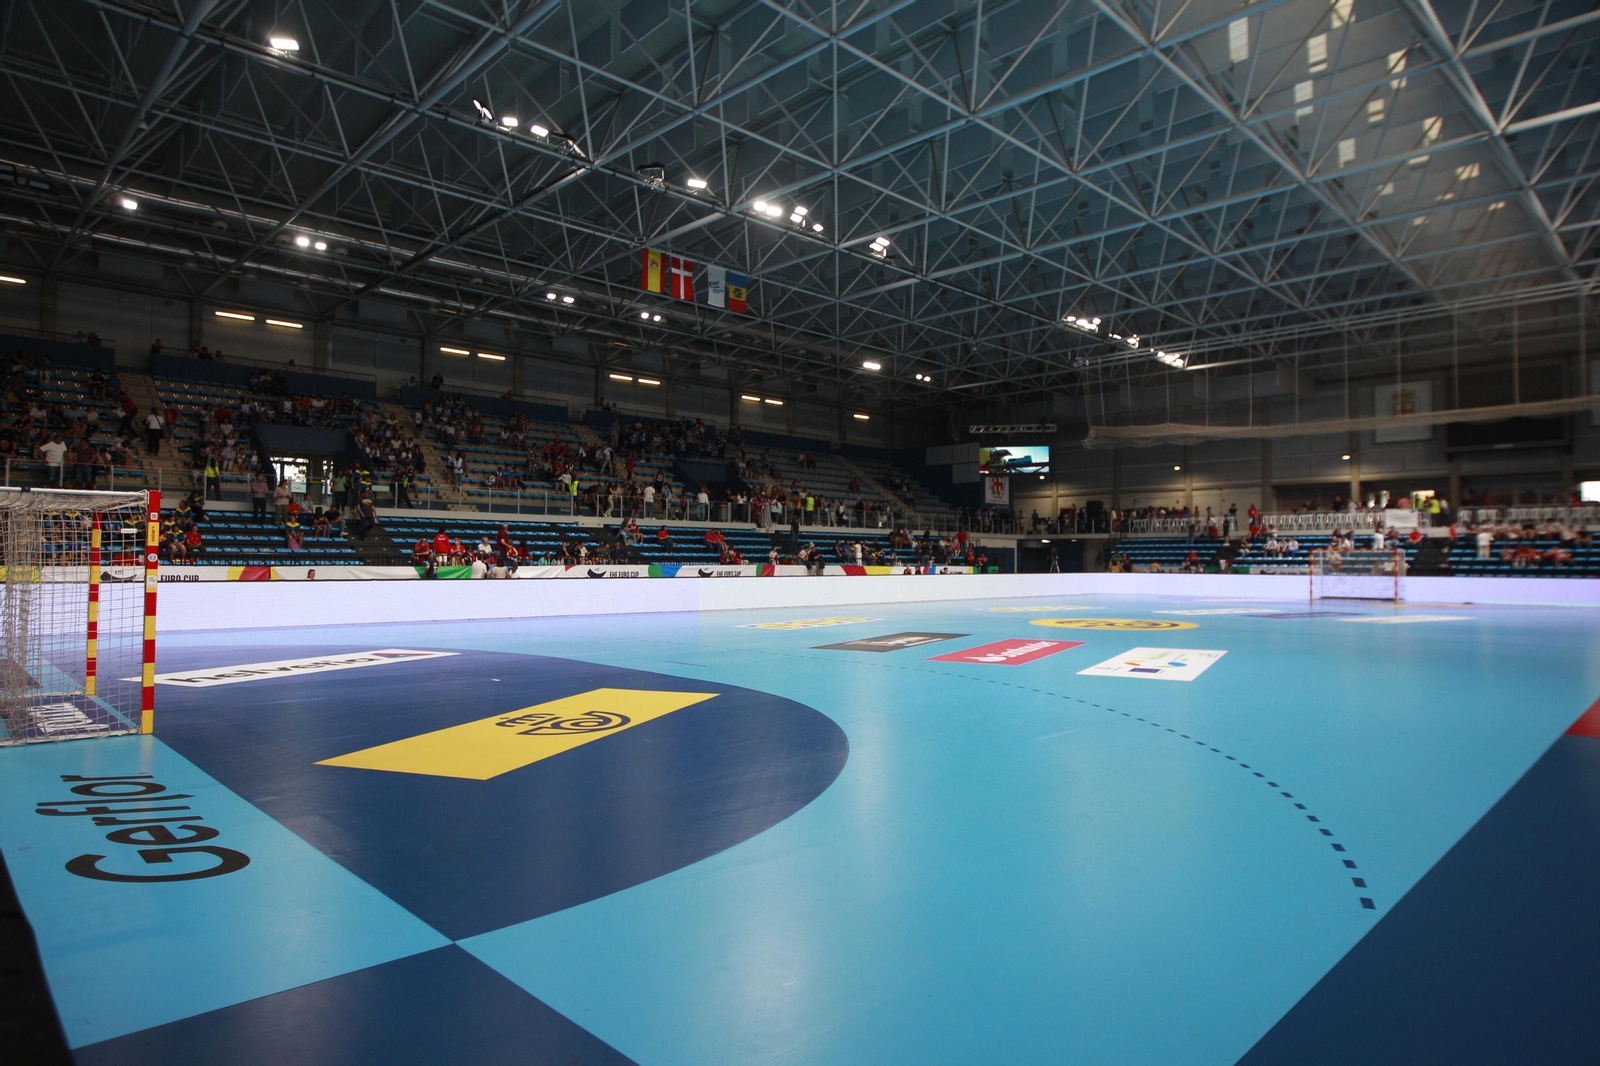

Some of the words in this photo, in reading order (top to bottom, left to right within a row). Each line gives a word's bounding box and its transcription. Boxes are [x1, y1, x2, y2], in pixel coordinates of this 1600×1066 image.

[987, 641, 1059, 658] Santander
[164, 657, 380, 683] helvetia
[35, 774, 250, 883] Gerflor
